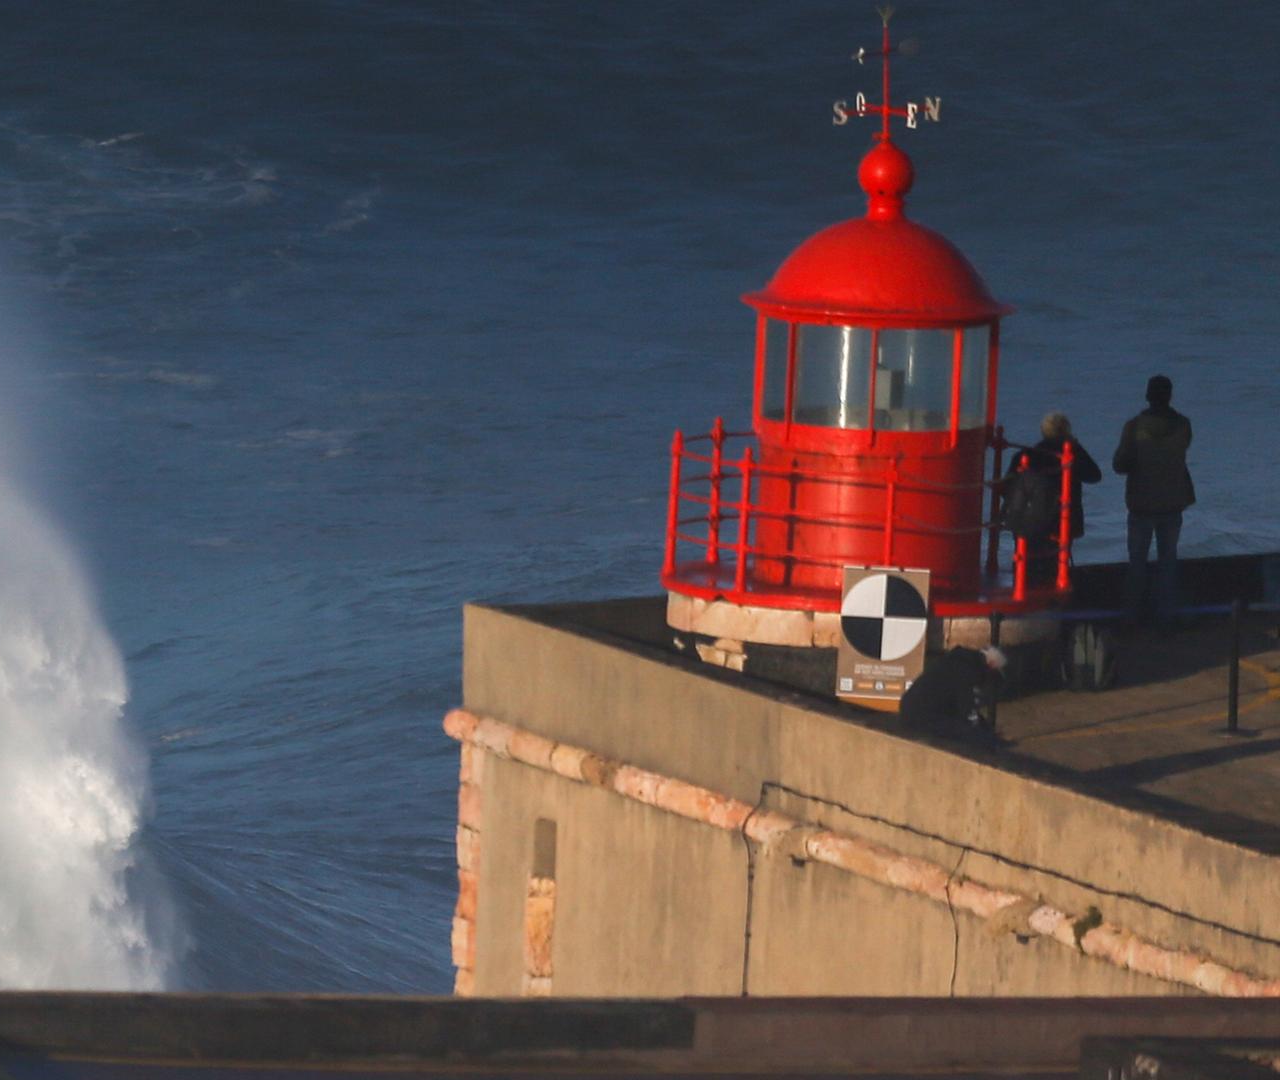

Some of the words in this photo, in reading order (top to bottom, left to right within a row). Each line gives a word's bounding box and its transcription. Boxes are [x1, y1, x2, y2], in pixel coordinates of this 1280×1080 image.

[832, 100, 848, 126] S
[906, 102, 918, 129] E
[924, 96, 941, 122] N
